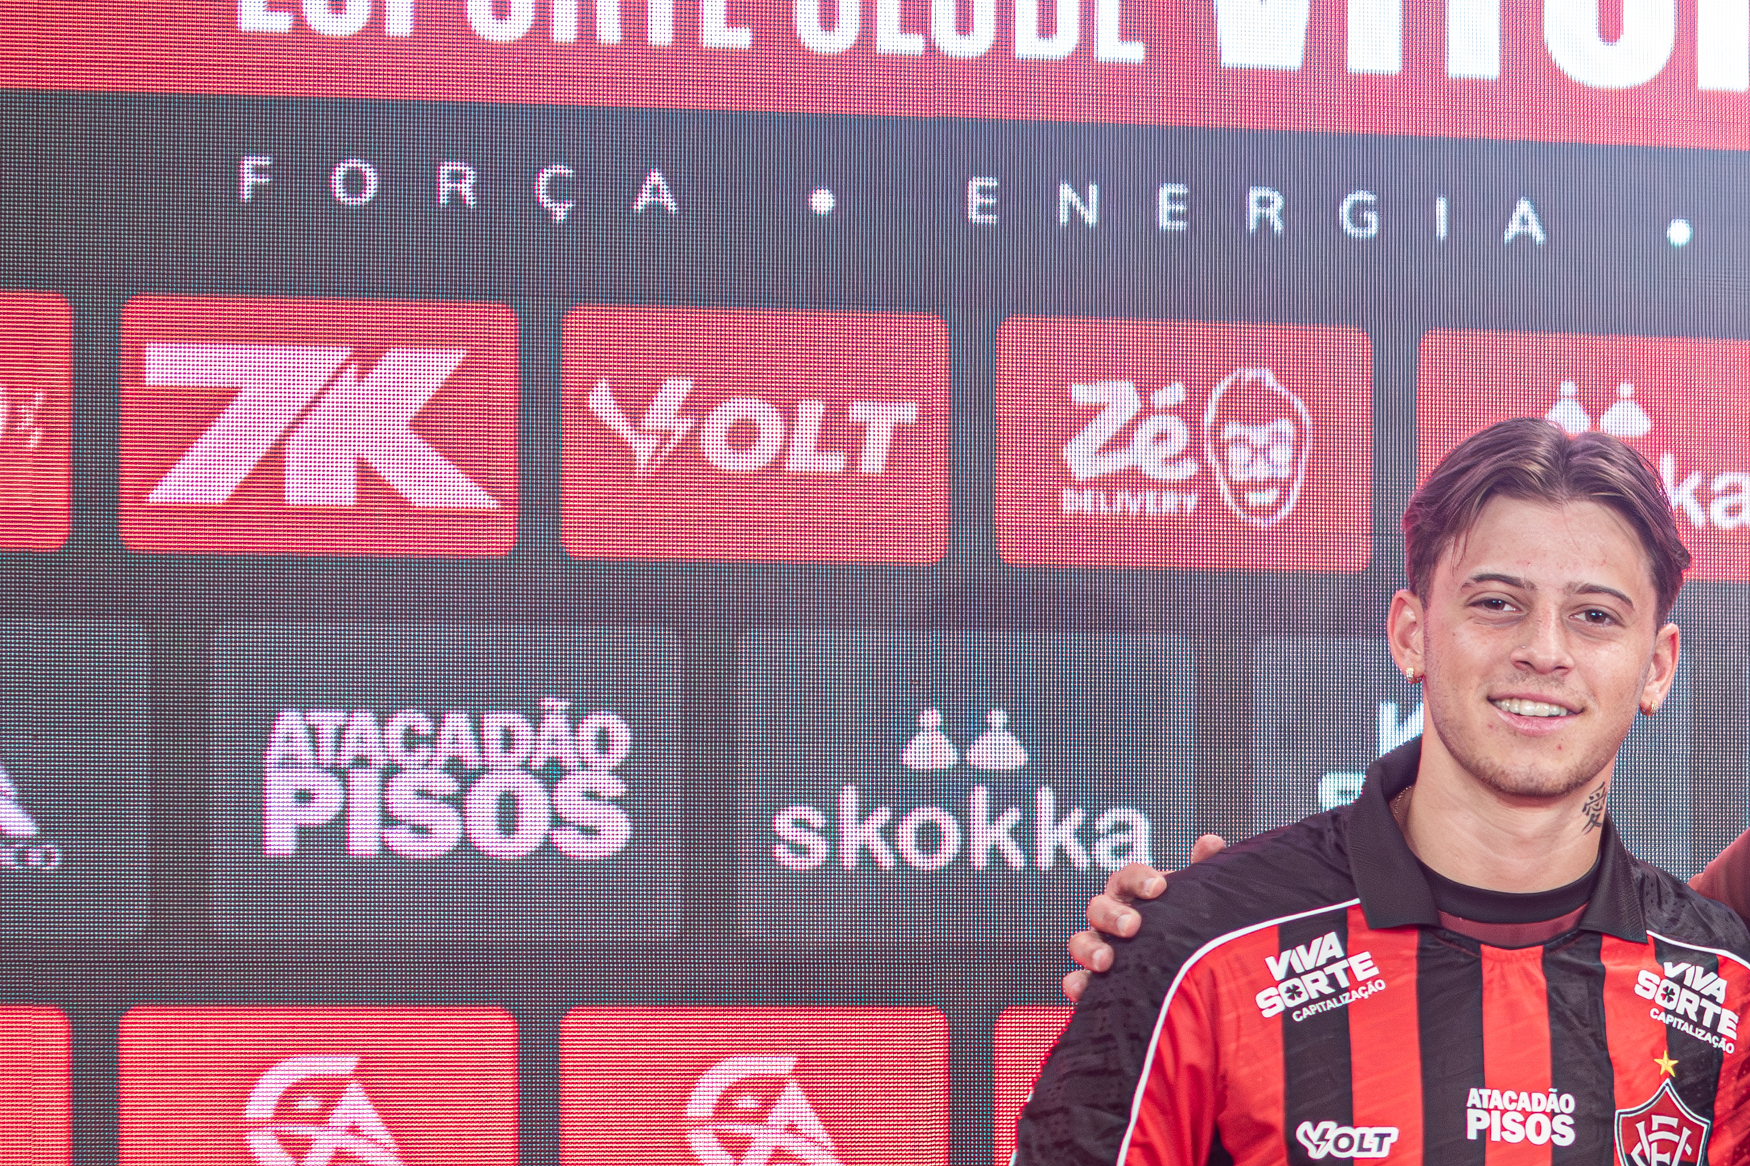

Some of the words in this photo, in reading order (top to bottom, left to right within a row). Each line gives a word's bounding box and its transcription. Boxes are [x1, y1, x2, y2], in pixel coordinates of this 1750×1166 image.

[237, 155, 679, 223] FORÇA
[966, 175, 1546, 246] ENERGIA
[145, 342, 501, 510] 7K
[587, 376, 919, 483] VOLT
[1061, 379, 1200, 483] Zé
[1061, 489, 1200, 516] DELIVERY
[263, 696, 634, 769] ATACADÃO
[263, 768, 634, 859] PISOS
[771, 784, 1154, 871] skokka
[1265, 930, 1346, 981] VIVA
[1662, 960, 1729, 1003] VIVA
[1291, 978, 1387, 1023] CAPITALIZAÇÃO
[1648, 1006, 1736, 1055] CAPITALIZAÇÃO
[1466, 1088, 1576, 1114] ATACADÃO
[1466, 1108, 1576, 1147] PISOS
[1297, 1120, 1399, 1159] VOLT
